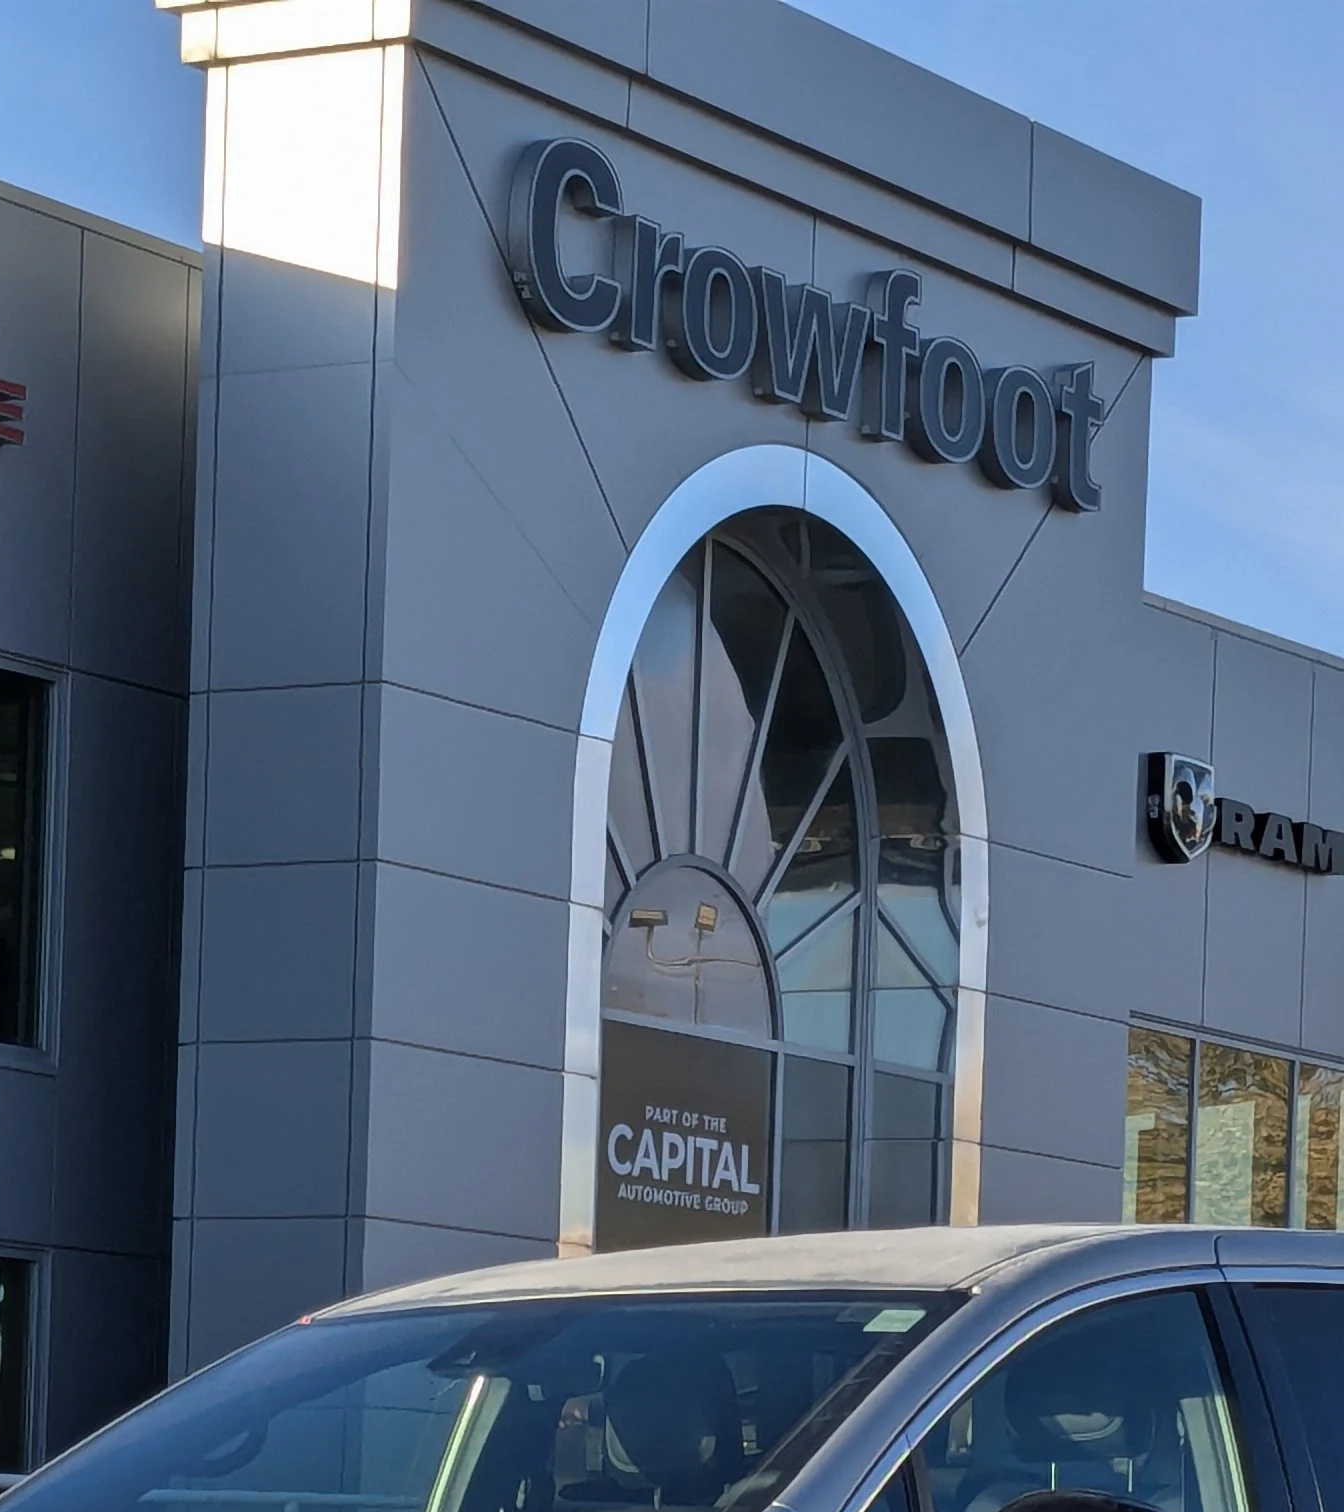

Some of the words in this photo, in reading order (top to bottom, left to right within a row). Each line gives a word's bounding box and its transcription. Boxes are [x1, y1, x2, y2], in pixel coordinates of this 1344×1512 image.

[526, 138, 1104, 512] Crowfoot
[645, 1105, 678, 1125] PART
[682, 1112, 700, 1129] OF
[703, 1115, 727, 1134] THE
[607, 1123, 760, 1194] CAPITAL
[617, 1182, 701, 1210] AUTOMOTIVE
[705, 1196, 749, 1215] GROUP
